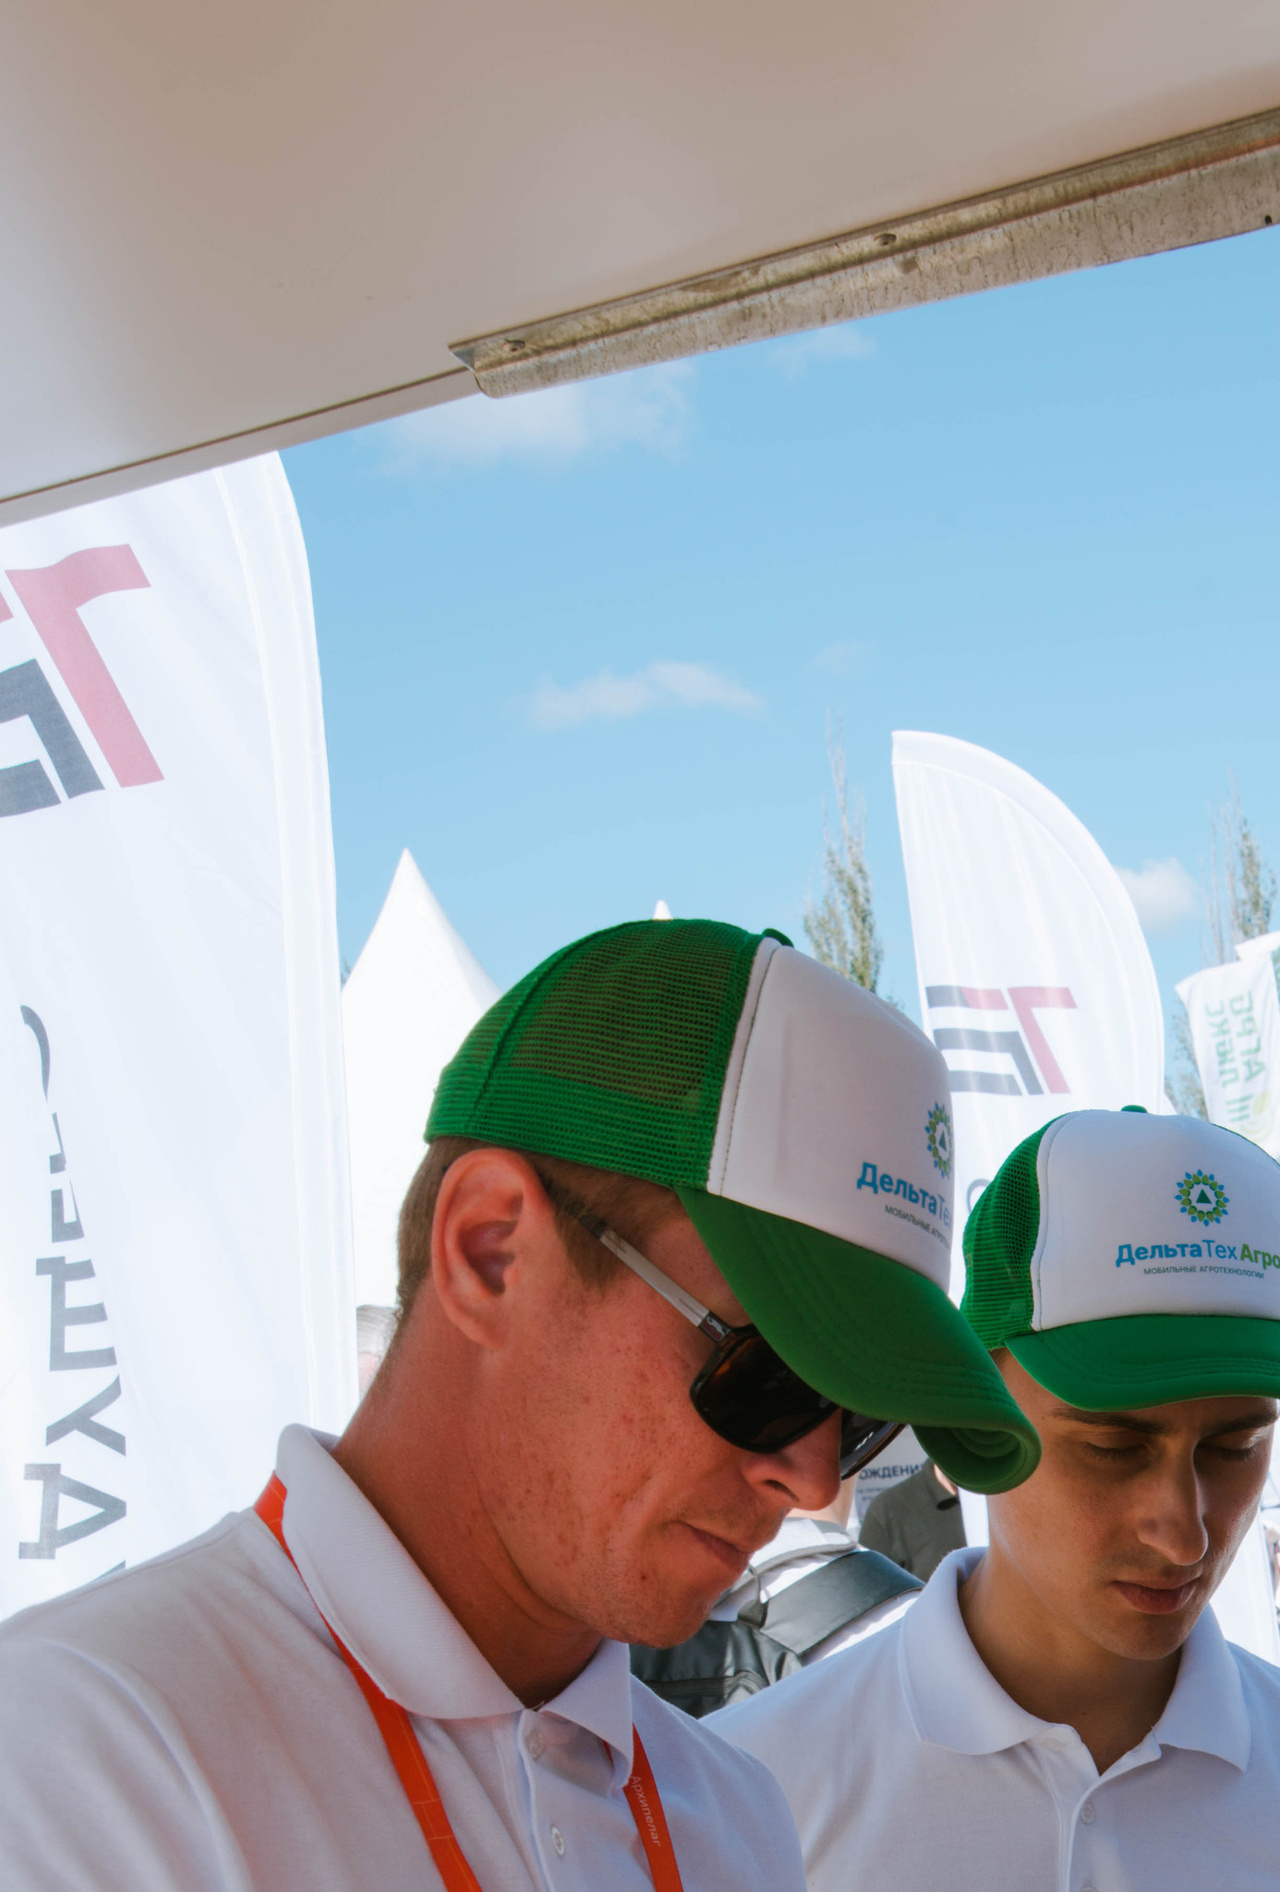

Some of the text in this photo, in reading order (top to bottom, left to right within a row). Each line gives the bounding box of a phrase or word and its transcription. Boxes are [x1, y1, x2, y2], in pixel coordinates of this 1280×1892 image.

[857, 1162, 951, 1227] ДельтаТе
[1143, 1265, 1265, 1279] МОБИЛЬНЫЕ АГРОТЕХНОЛОГИИ
[859, 1463, 925, 1480] ОЖДЕНИ
